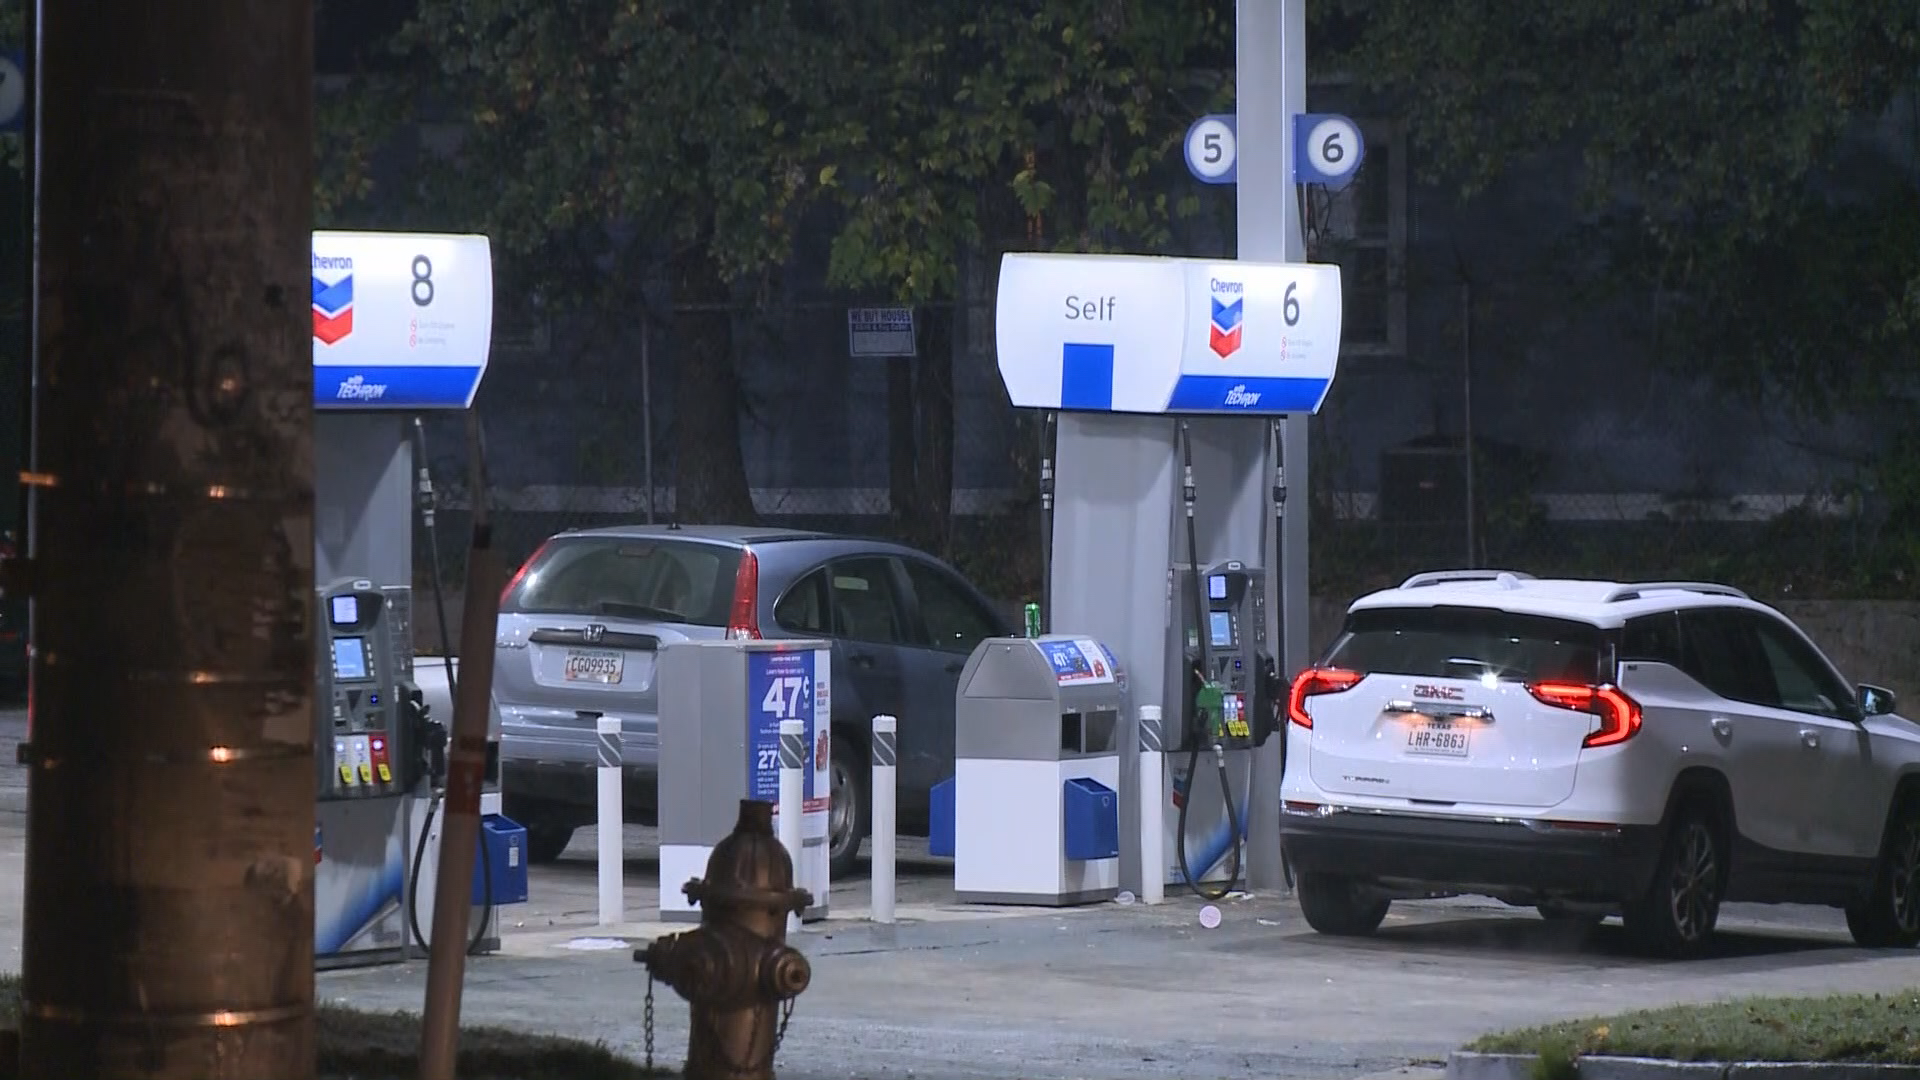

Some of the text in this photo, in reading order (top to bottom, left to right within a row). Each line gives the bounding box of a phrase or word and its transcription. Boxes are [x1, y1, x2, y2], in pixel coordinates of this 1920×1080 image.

[1203, 133, 1222, 164] 5
[1322, 132, 1344, 163] 6
[312, 250, 353, 270] hevron
[411, 253, 434, 307] 8
[1210, 276, 1244, 294] Chevron
[1065, 294, 1117, 322] Self
[1283, 280, 1300, 327] 6
[336, 382, 387, 401] TECHRON
[1224, 390, 1261, 408] TECHRON
[762, 675, 810, 719] 47¢
[757, 750, 780, 769] 27
